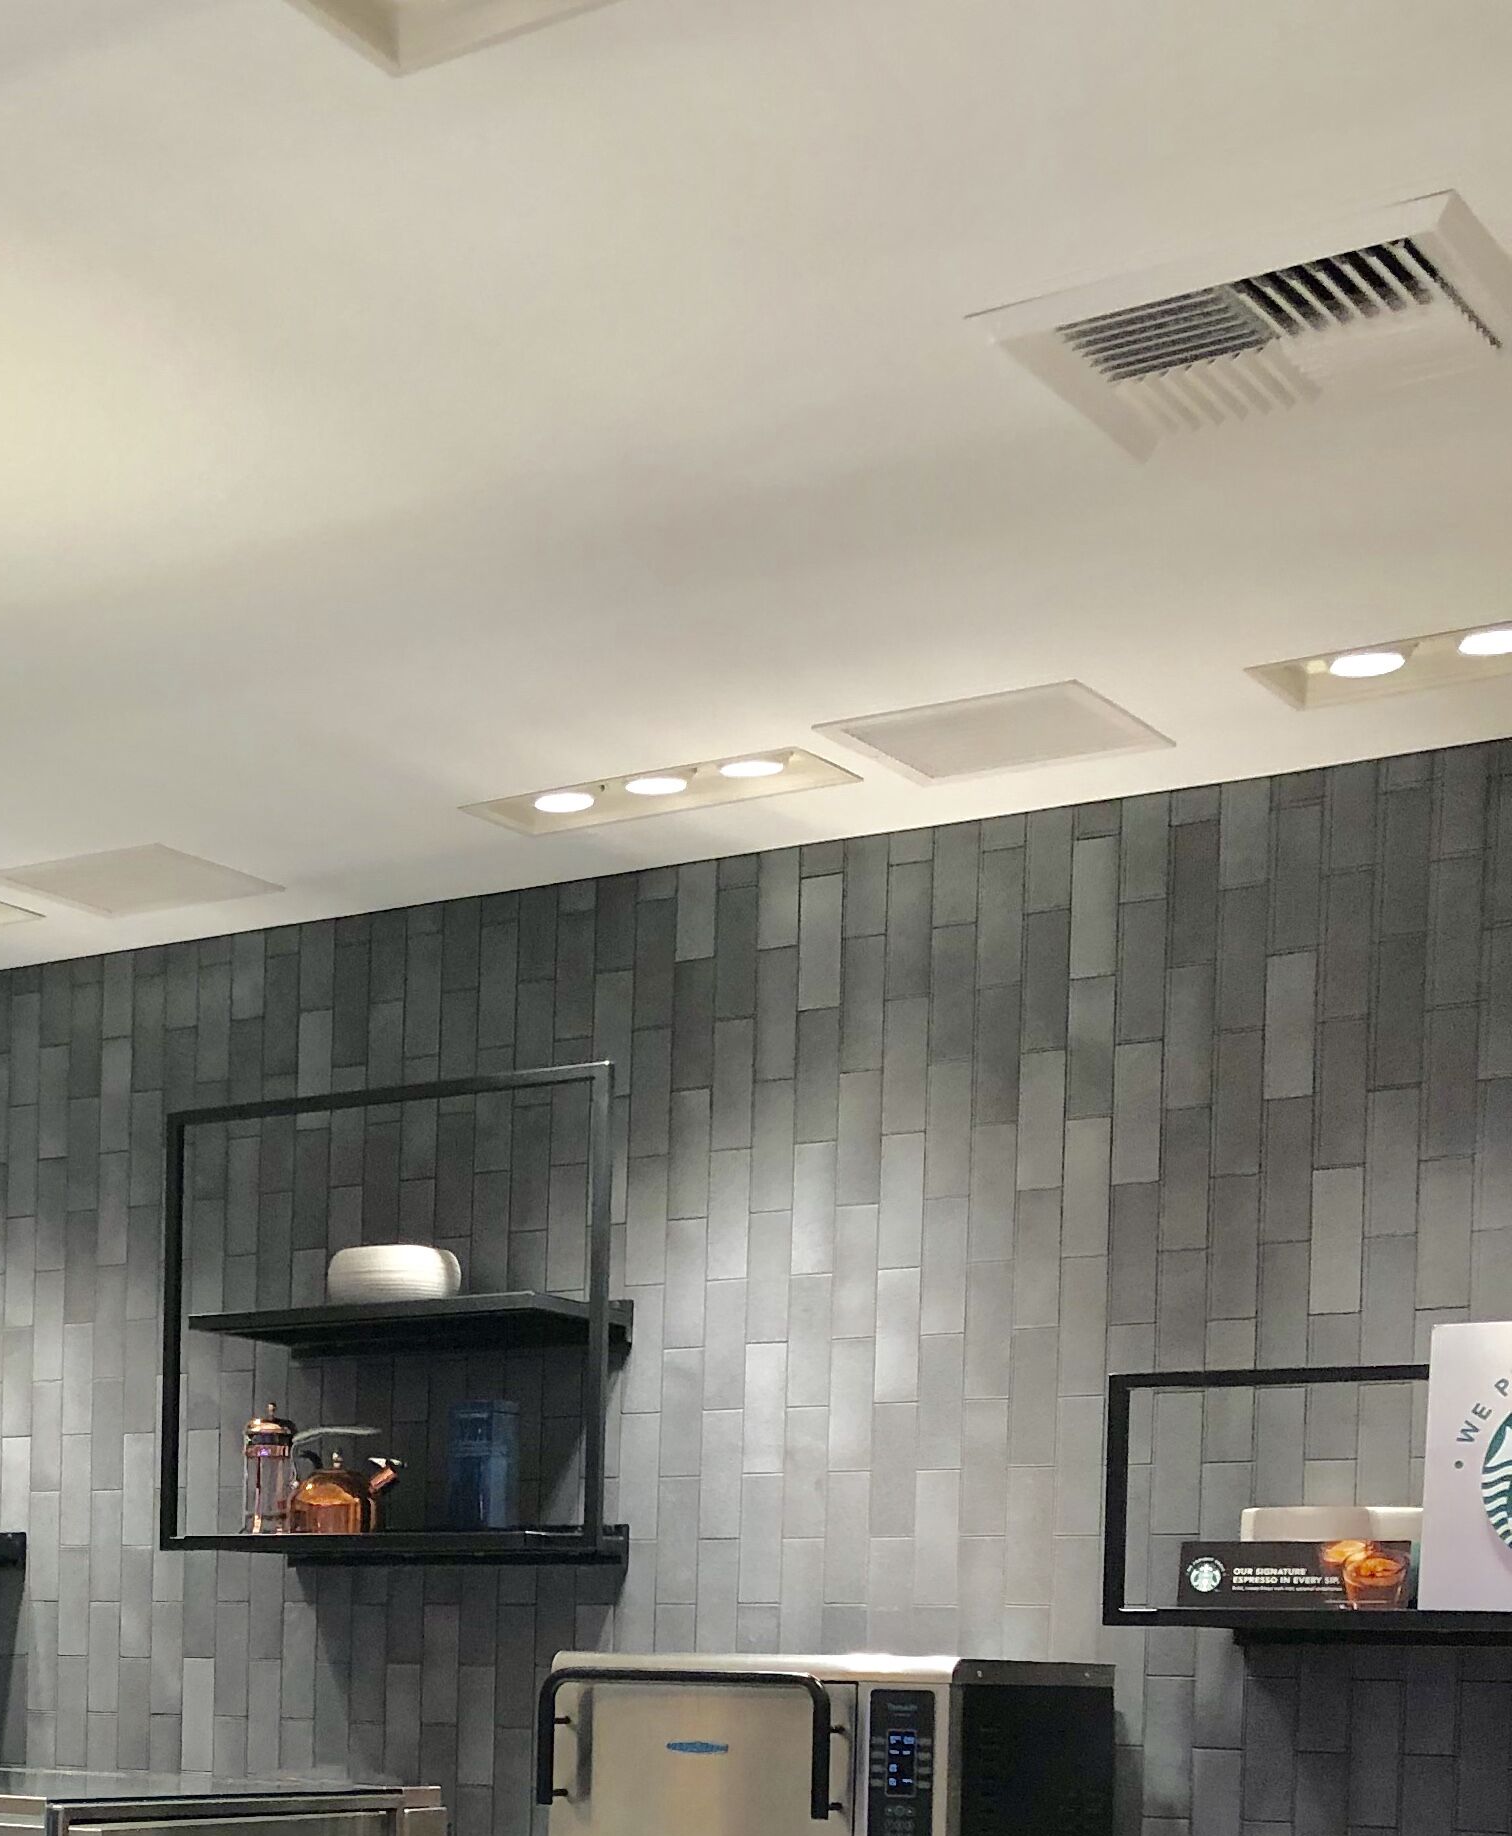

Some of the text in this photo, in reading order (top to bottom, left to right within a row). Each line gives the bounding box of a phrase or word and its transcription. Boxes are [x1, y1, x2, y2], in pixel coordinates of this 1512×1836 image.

[1456, 1402, 1492, 1443] WE
[1233, 1567, 1307, 1576] OUR SIGNATURE
[1232, 1576, 1278, 1584] ESPRESSO
[1279, 1576, 1291, 1584] IN
[1292, 1576, 1323, 1585] EVERY
